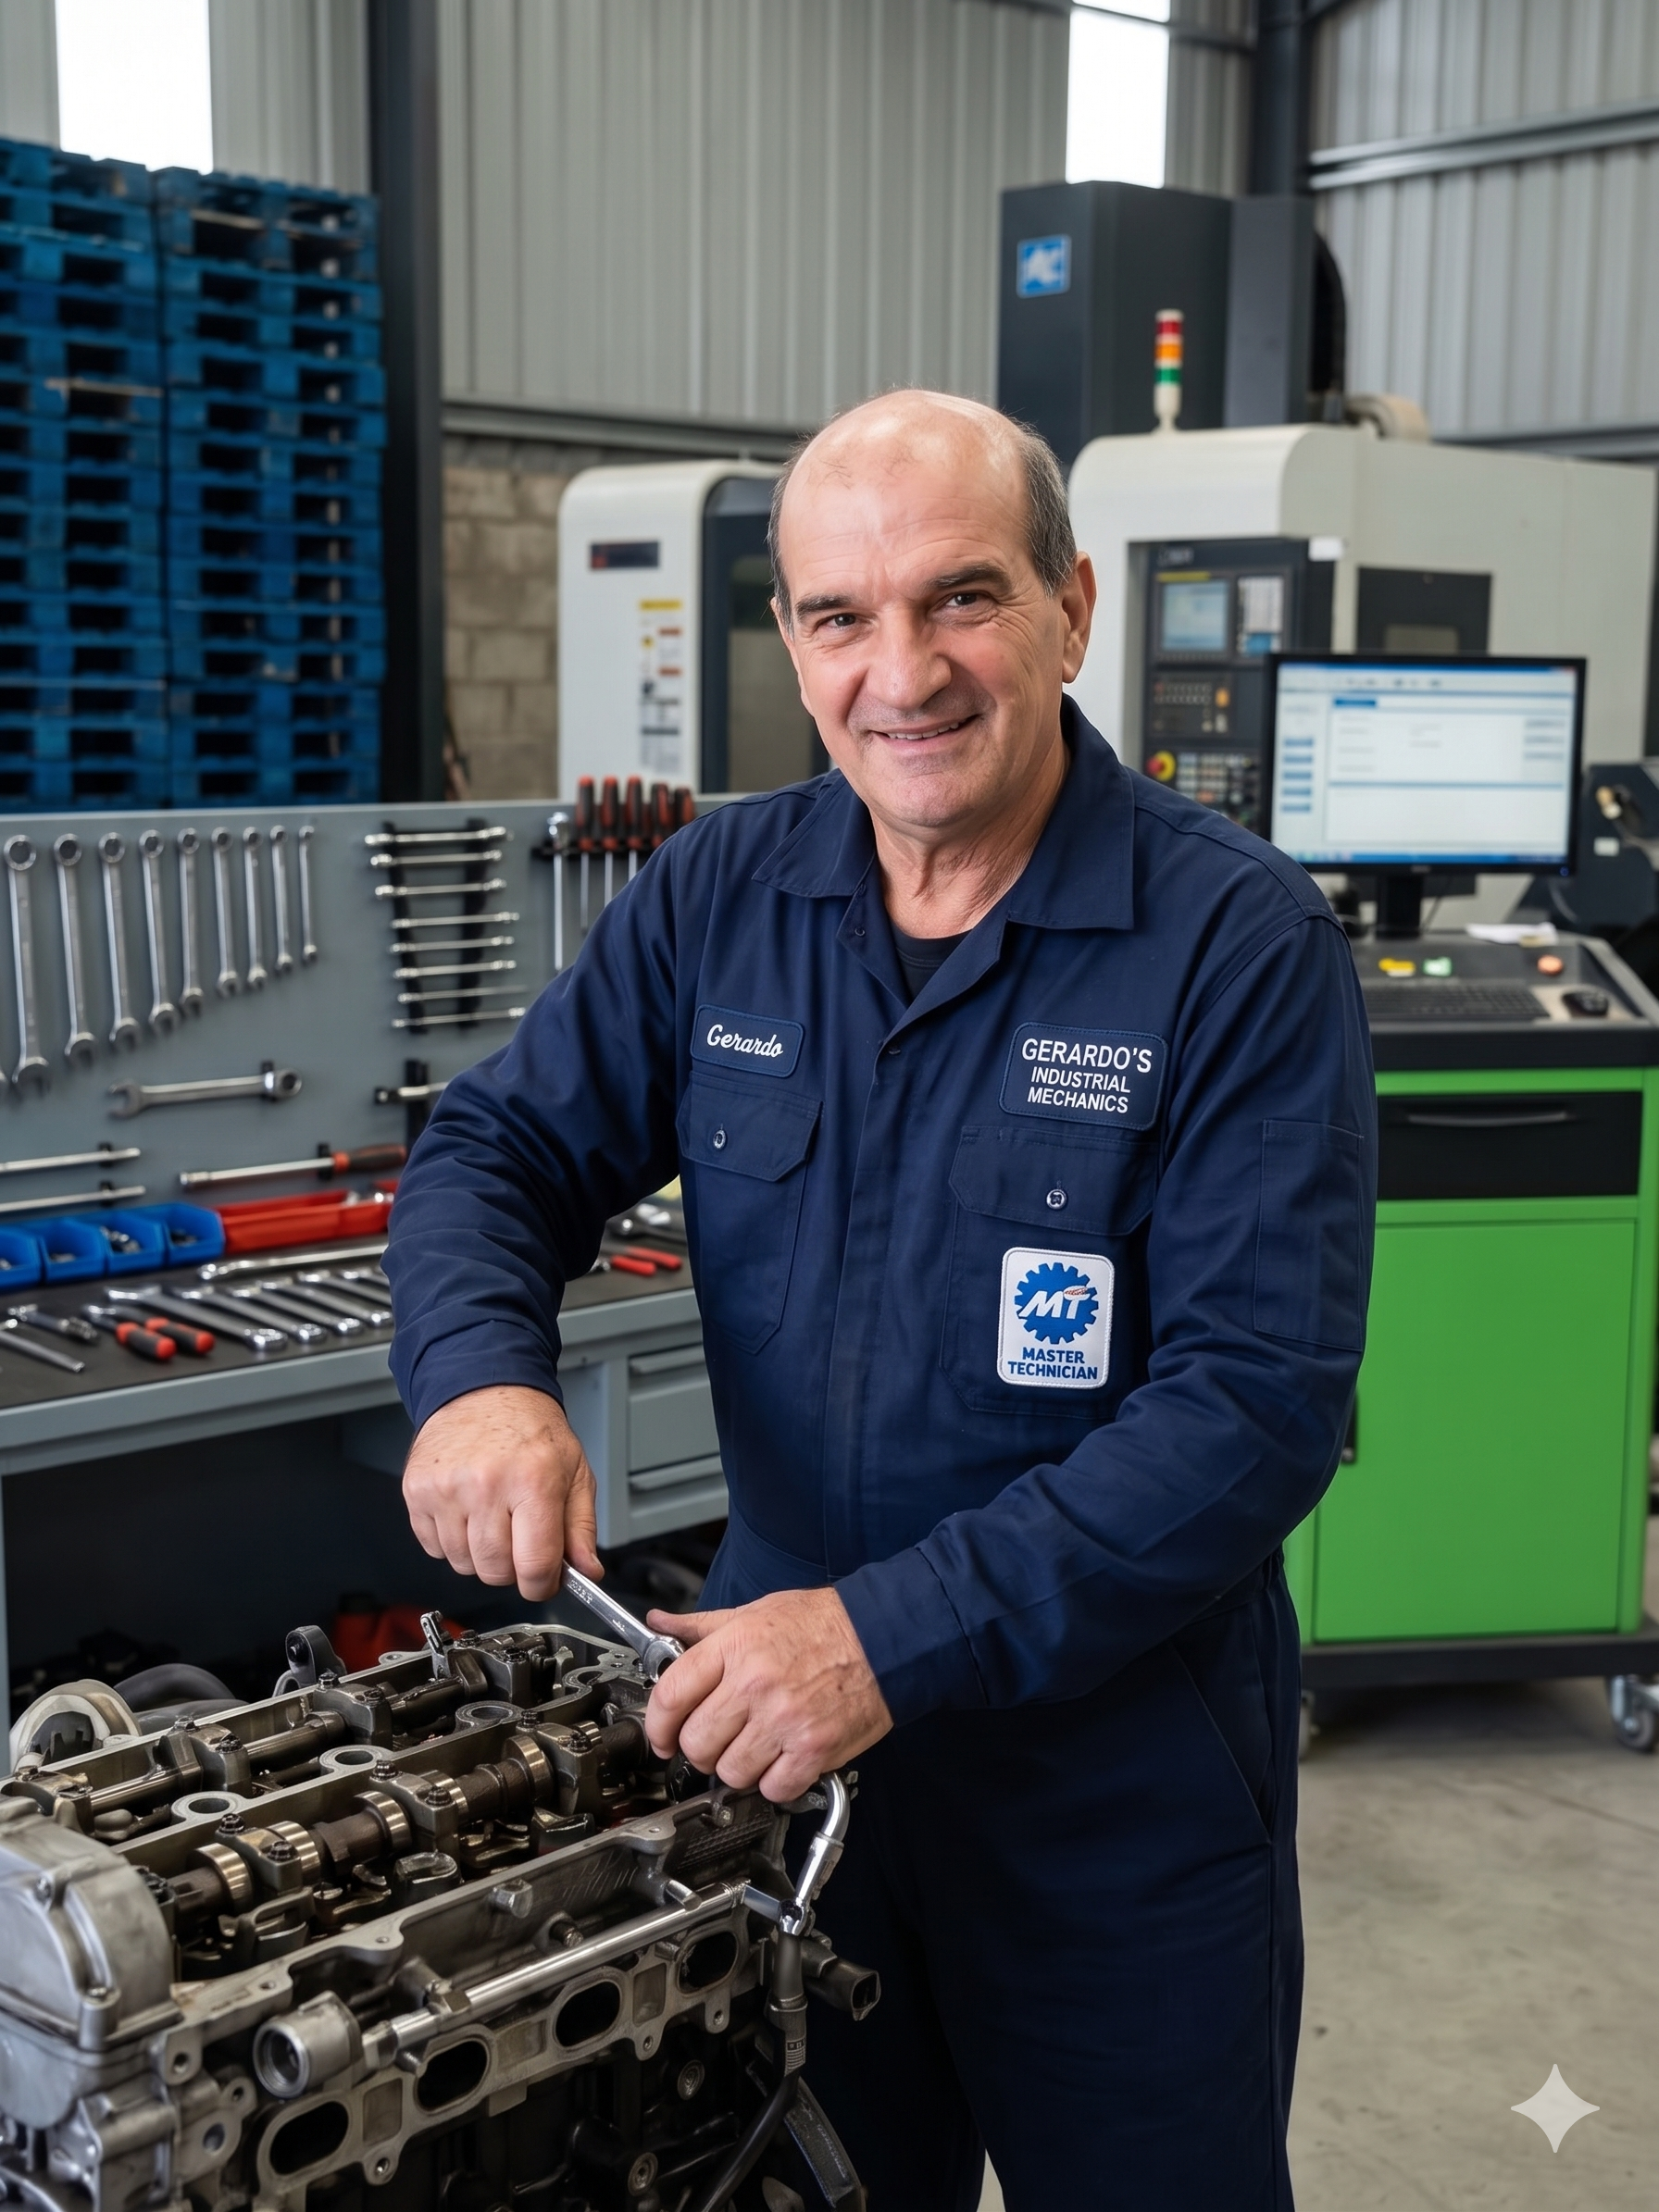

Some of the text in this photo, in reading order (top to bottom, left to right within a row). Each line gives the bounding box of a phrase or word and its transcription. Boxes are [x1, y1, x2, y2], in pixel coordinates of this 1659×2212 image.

[706, 1024, 784, 1058] Gerardo
[1021, 1038, 1153, 1074] GERARDO'S
[1030, 1065, 1131, 1094] INDUSTRIAL
[1027, 1086, 1129, 1113] MECHANICS
[1018, 1286, 1091, 1320] MT
[1022, 1347, 1085, 1364] MASTER
[1007, 1361, 1098, 1380] TECHNICIAN
